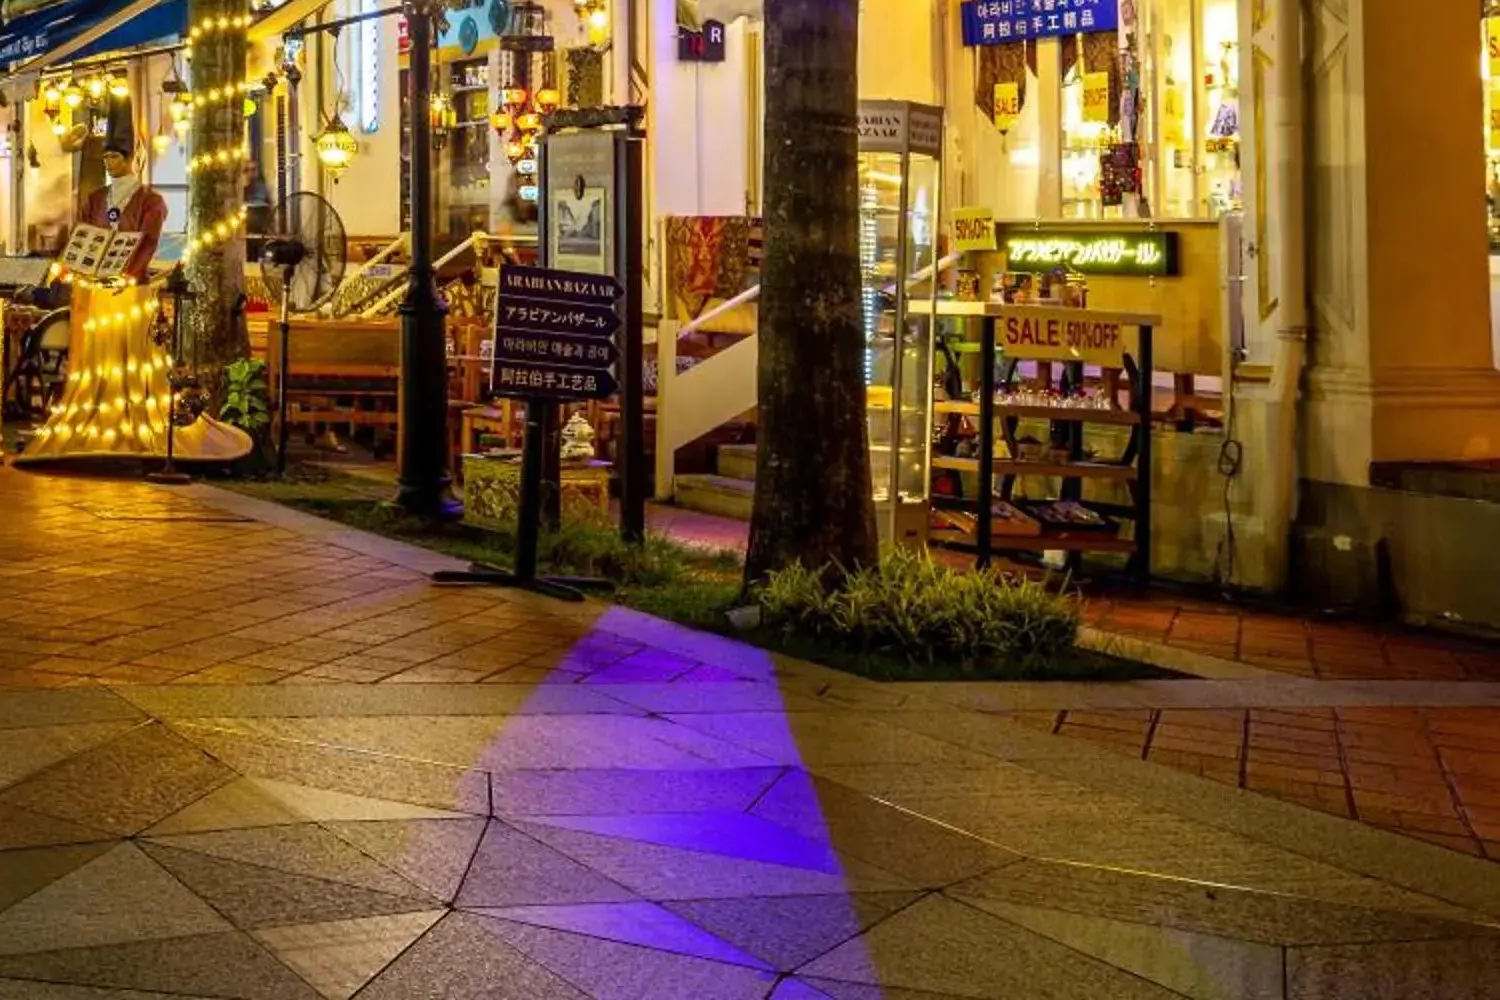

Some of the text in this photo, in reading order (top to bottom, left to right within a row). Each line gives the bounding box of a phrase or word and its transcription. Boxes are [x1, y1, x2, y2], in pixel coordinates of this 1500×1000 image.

[506, 274, 615, 297] ARABIAN BAZAAR
[505, 306, 607, 328] アラビアンバザール
[1006, 316, 1119, 349] SALE 50%OFF
